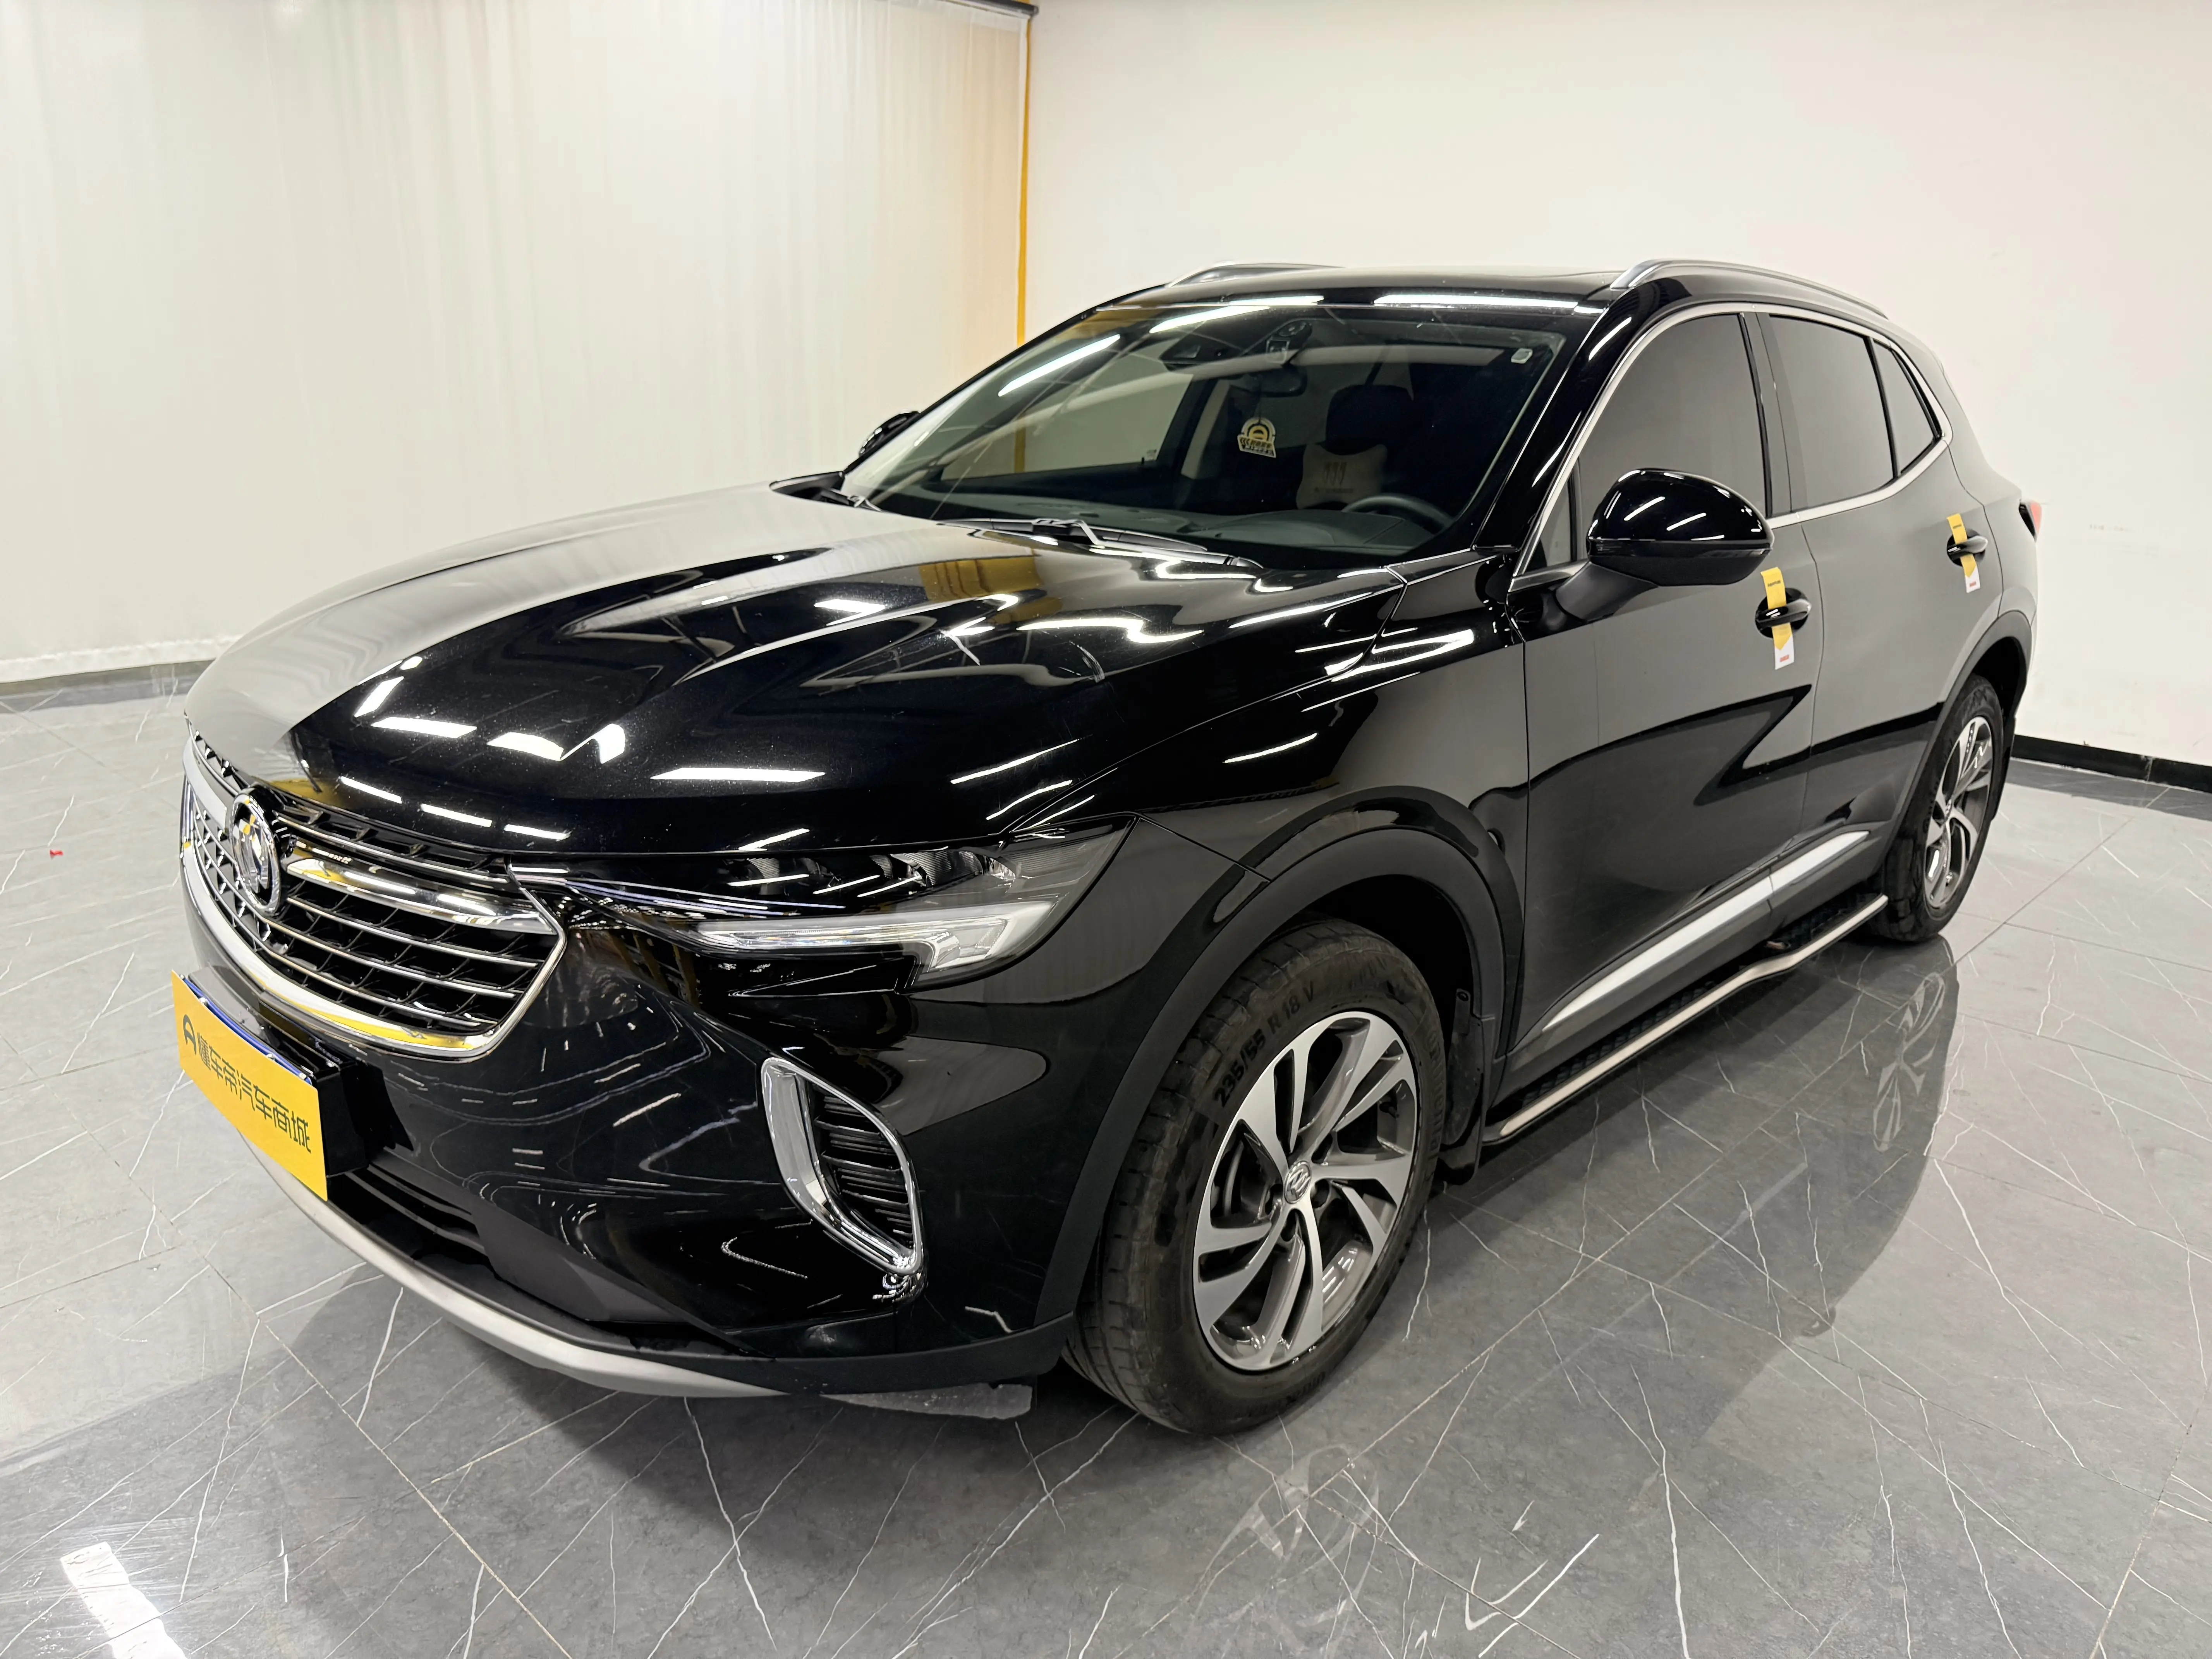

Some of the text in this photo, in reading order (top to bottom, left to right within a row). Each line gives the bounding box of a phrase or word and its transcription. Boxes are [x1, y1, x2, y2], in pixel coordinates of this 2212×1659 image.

[197, 1032, 311, 1153] 懂车帝汽车商城
[1214, 1029, 1266, 1108] 235/55
